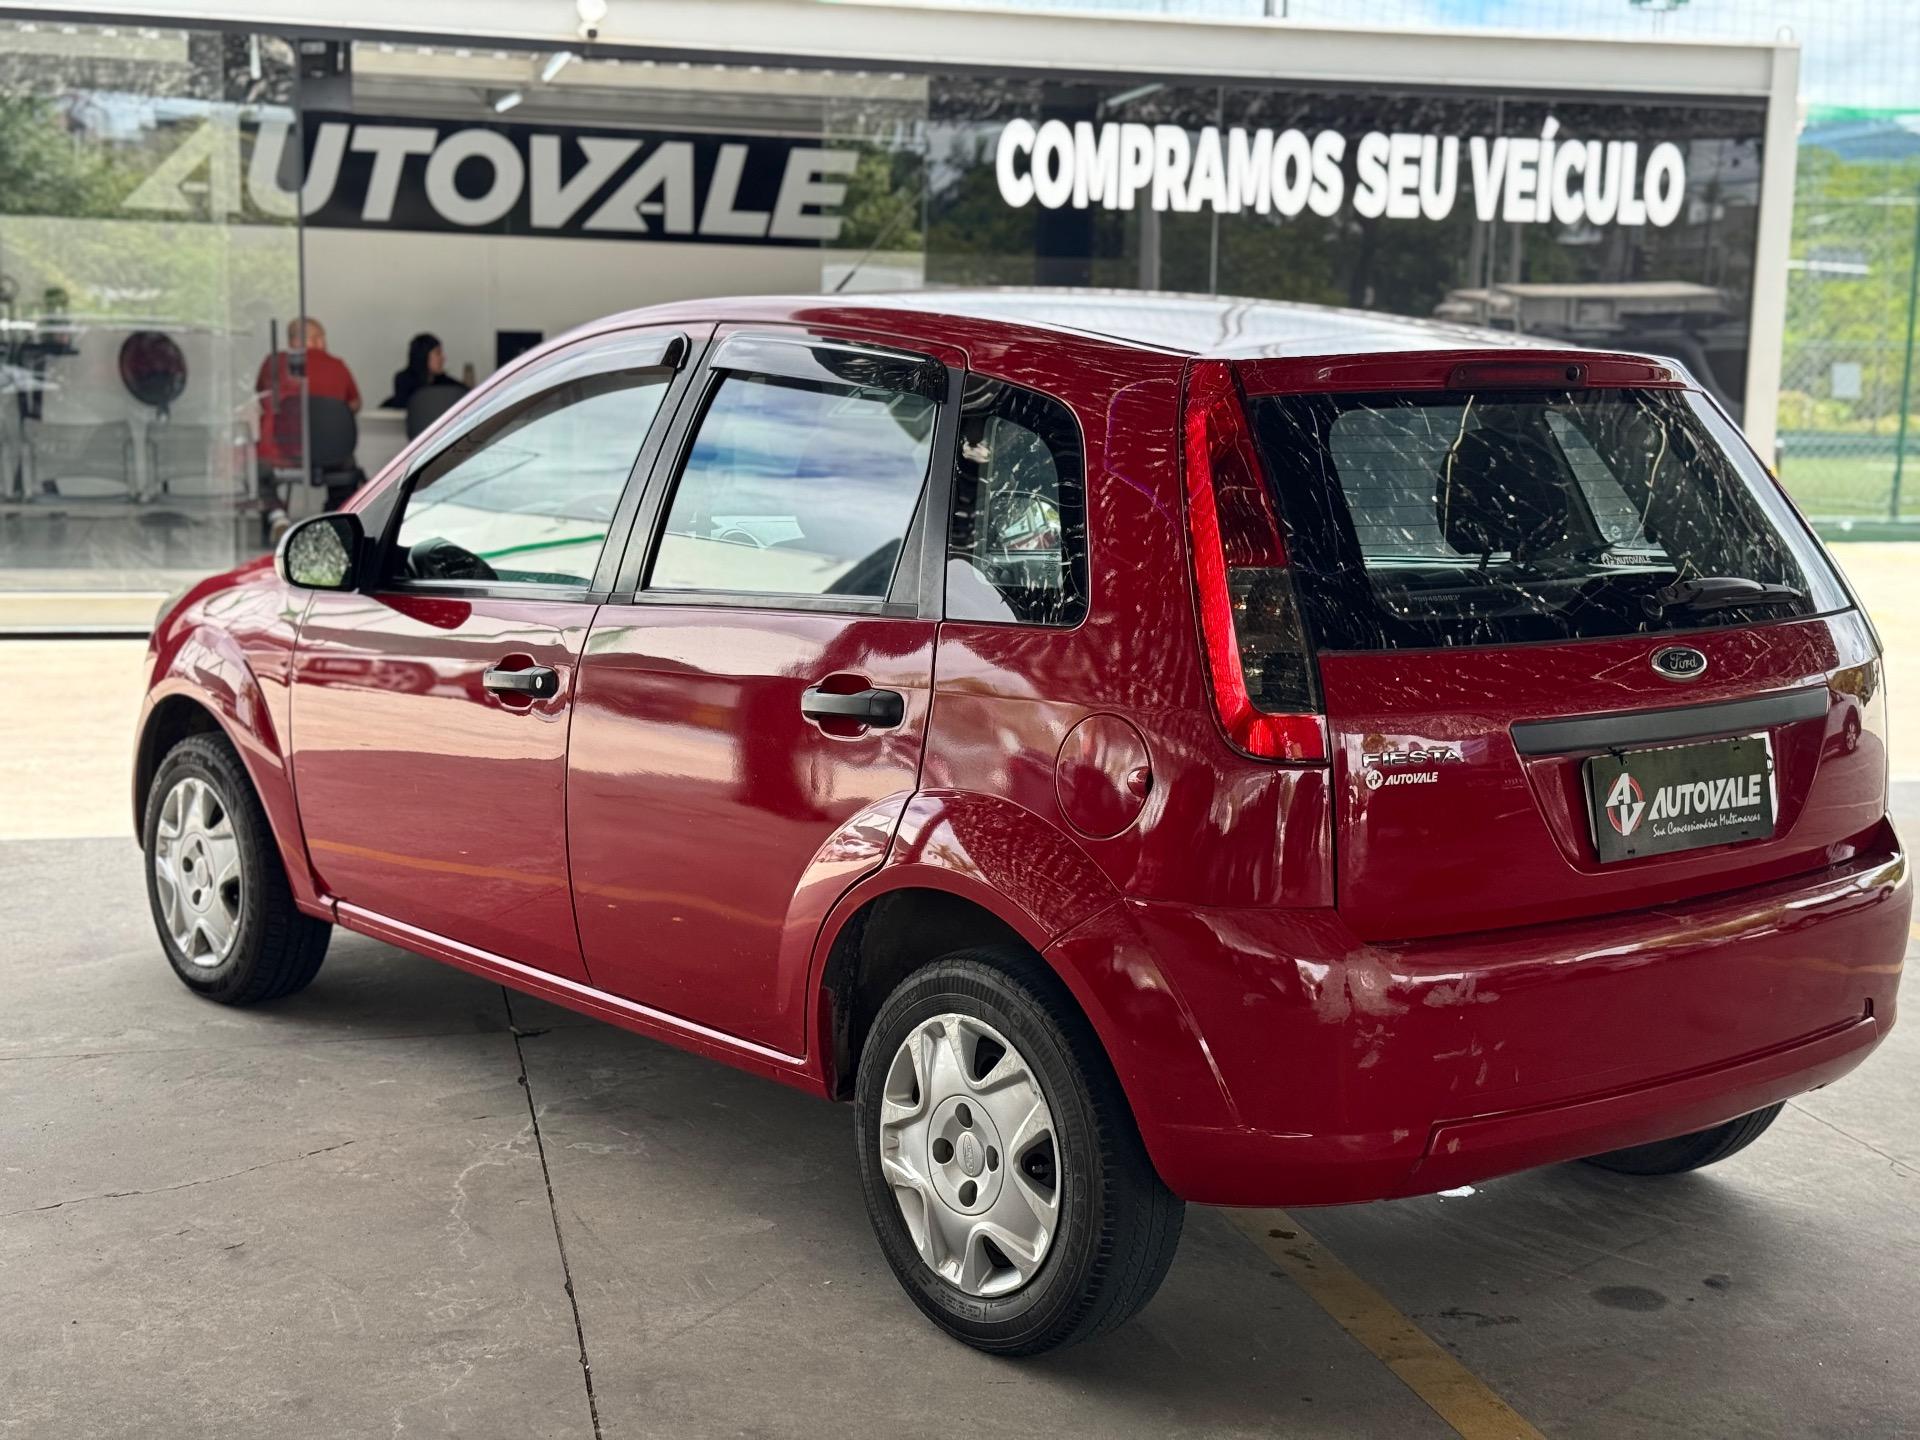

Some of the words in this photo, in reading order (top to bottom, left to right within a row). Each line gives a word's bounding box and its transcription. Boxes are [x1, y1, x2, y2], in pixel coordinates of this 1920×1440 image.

[122, 106, 861, 238] AUTOVALE
[996, 118, 1347, 217] COMPRAMOS
[1352, 130, 1460, 220] SEU
[1470, 115, 1686, 228] VEÍCULO
[1669, 651, 1698, 670] Ford
[1361, 747, 1465, 768] FIESTA
[1384, 771, 1439, 786] AUTOVALE
[1647, 773, 1762, 821] AUTOVALE
[1652, 823, 1666, 838] Sua
